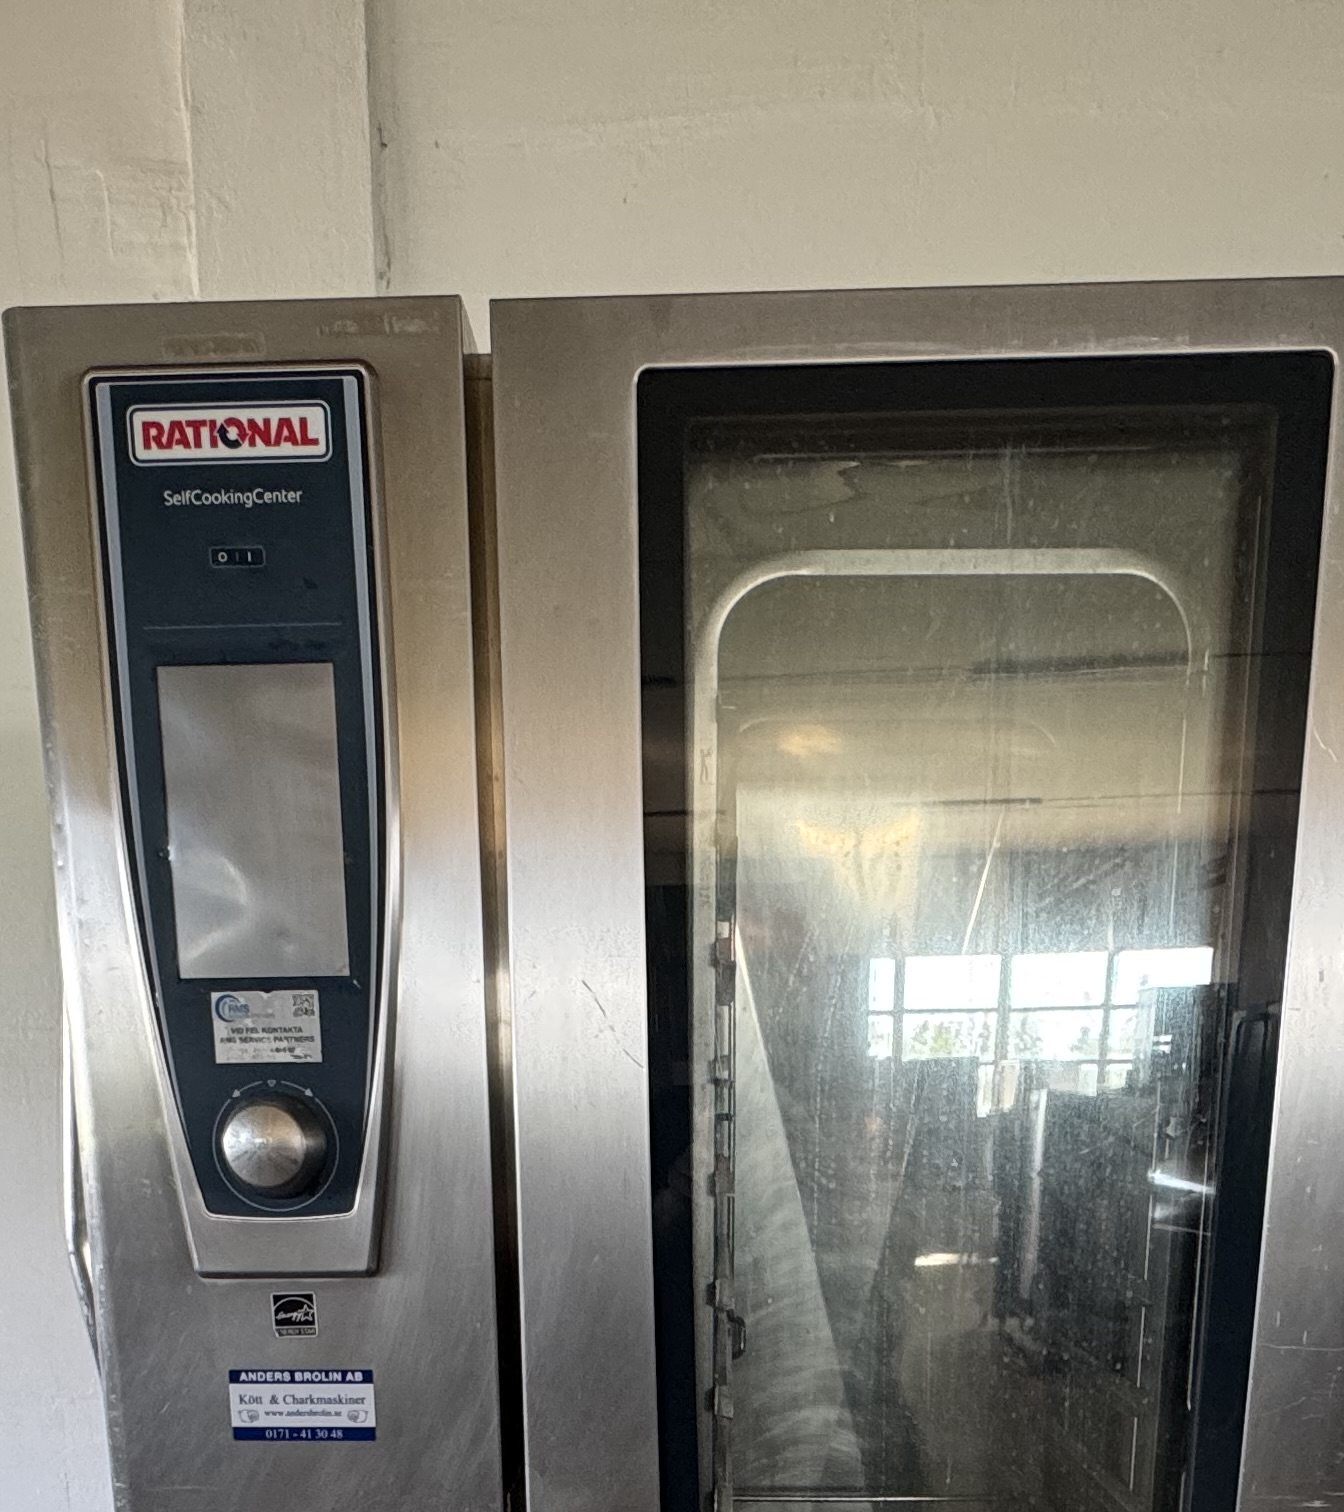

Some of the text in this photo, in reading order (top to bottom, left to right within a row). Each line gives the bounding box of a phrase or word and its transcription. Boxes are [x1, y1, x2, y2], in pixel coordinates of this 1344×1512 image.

[141, 416, 320, 450] RATIONAL
[163, 488, 303, 508] SelfCookingCenter
[230, 1026, 303, 1035] VID FEL KONTAKTA
[274, 1036, 315, 1044] PARTNERS
[239, 1371, 363, 1382] ANDERS BROLIN AB
[239, 1394, 366, 1405] Kött & Charkmaskiner
[265, 1429, 290, 1439] 0171
[300, 1429, 312, 1439] 41
[315, 1429, 328, 1439] 30
[330, 1429, 344, 1439] 48
